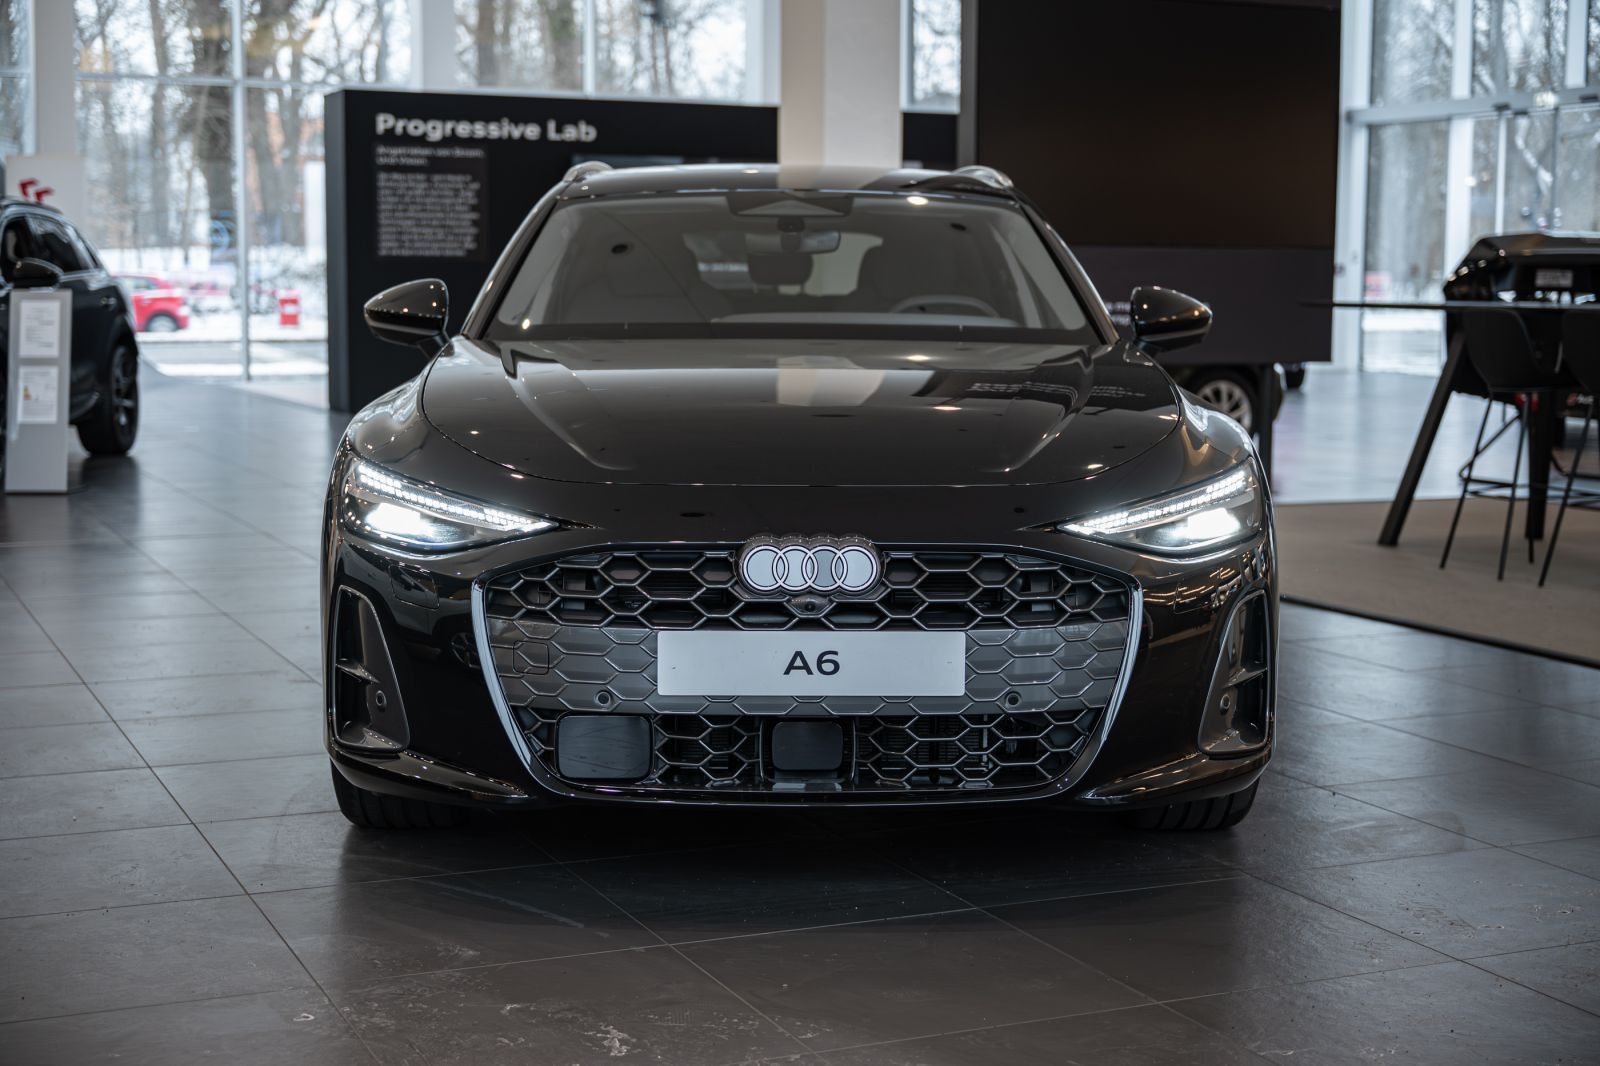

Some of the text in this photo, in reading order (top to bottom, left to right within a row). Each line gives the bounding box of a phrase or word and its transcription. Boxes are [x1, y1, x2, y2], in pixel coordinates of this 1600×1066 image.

[375, 112, 598, 142] Progressive Lab
[783, 650, 840, 676] A6
